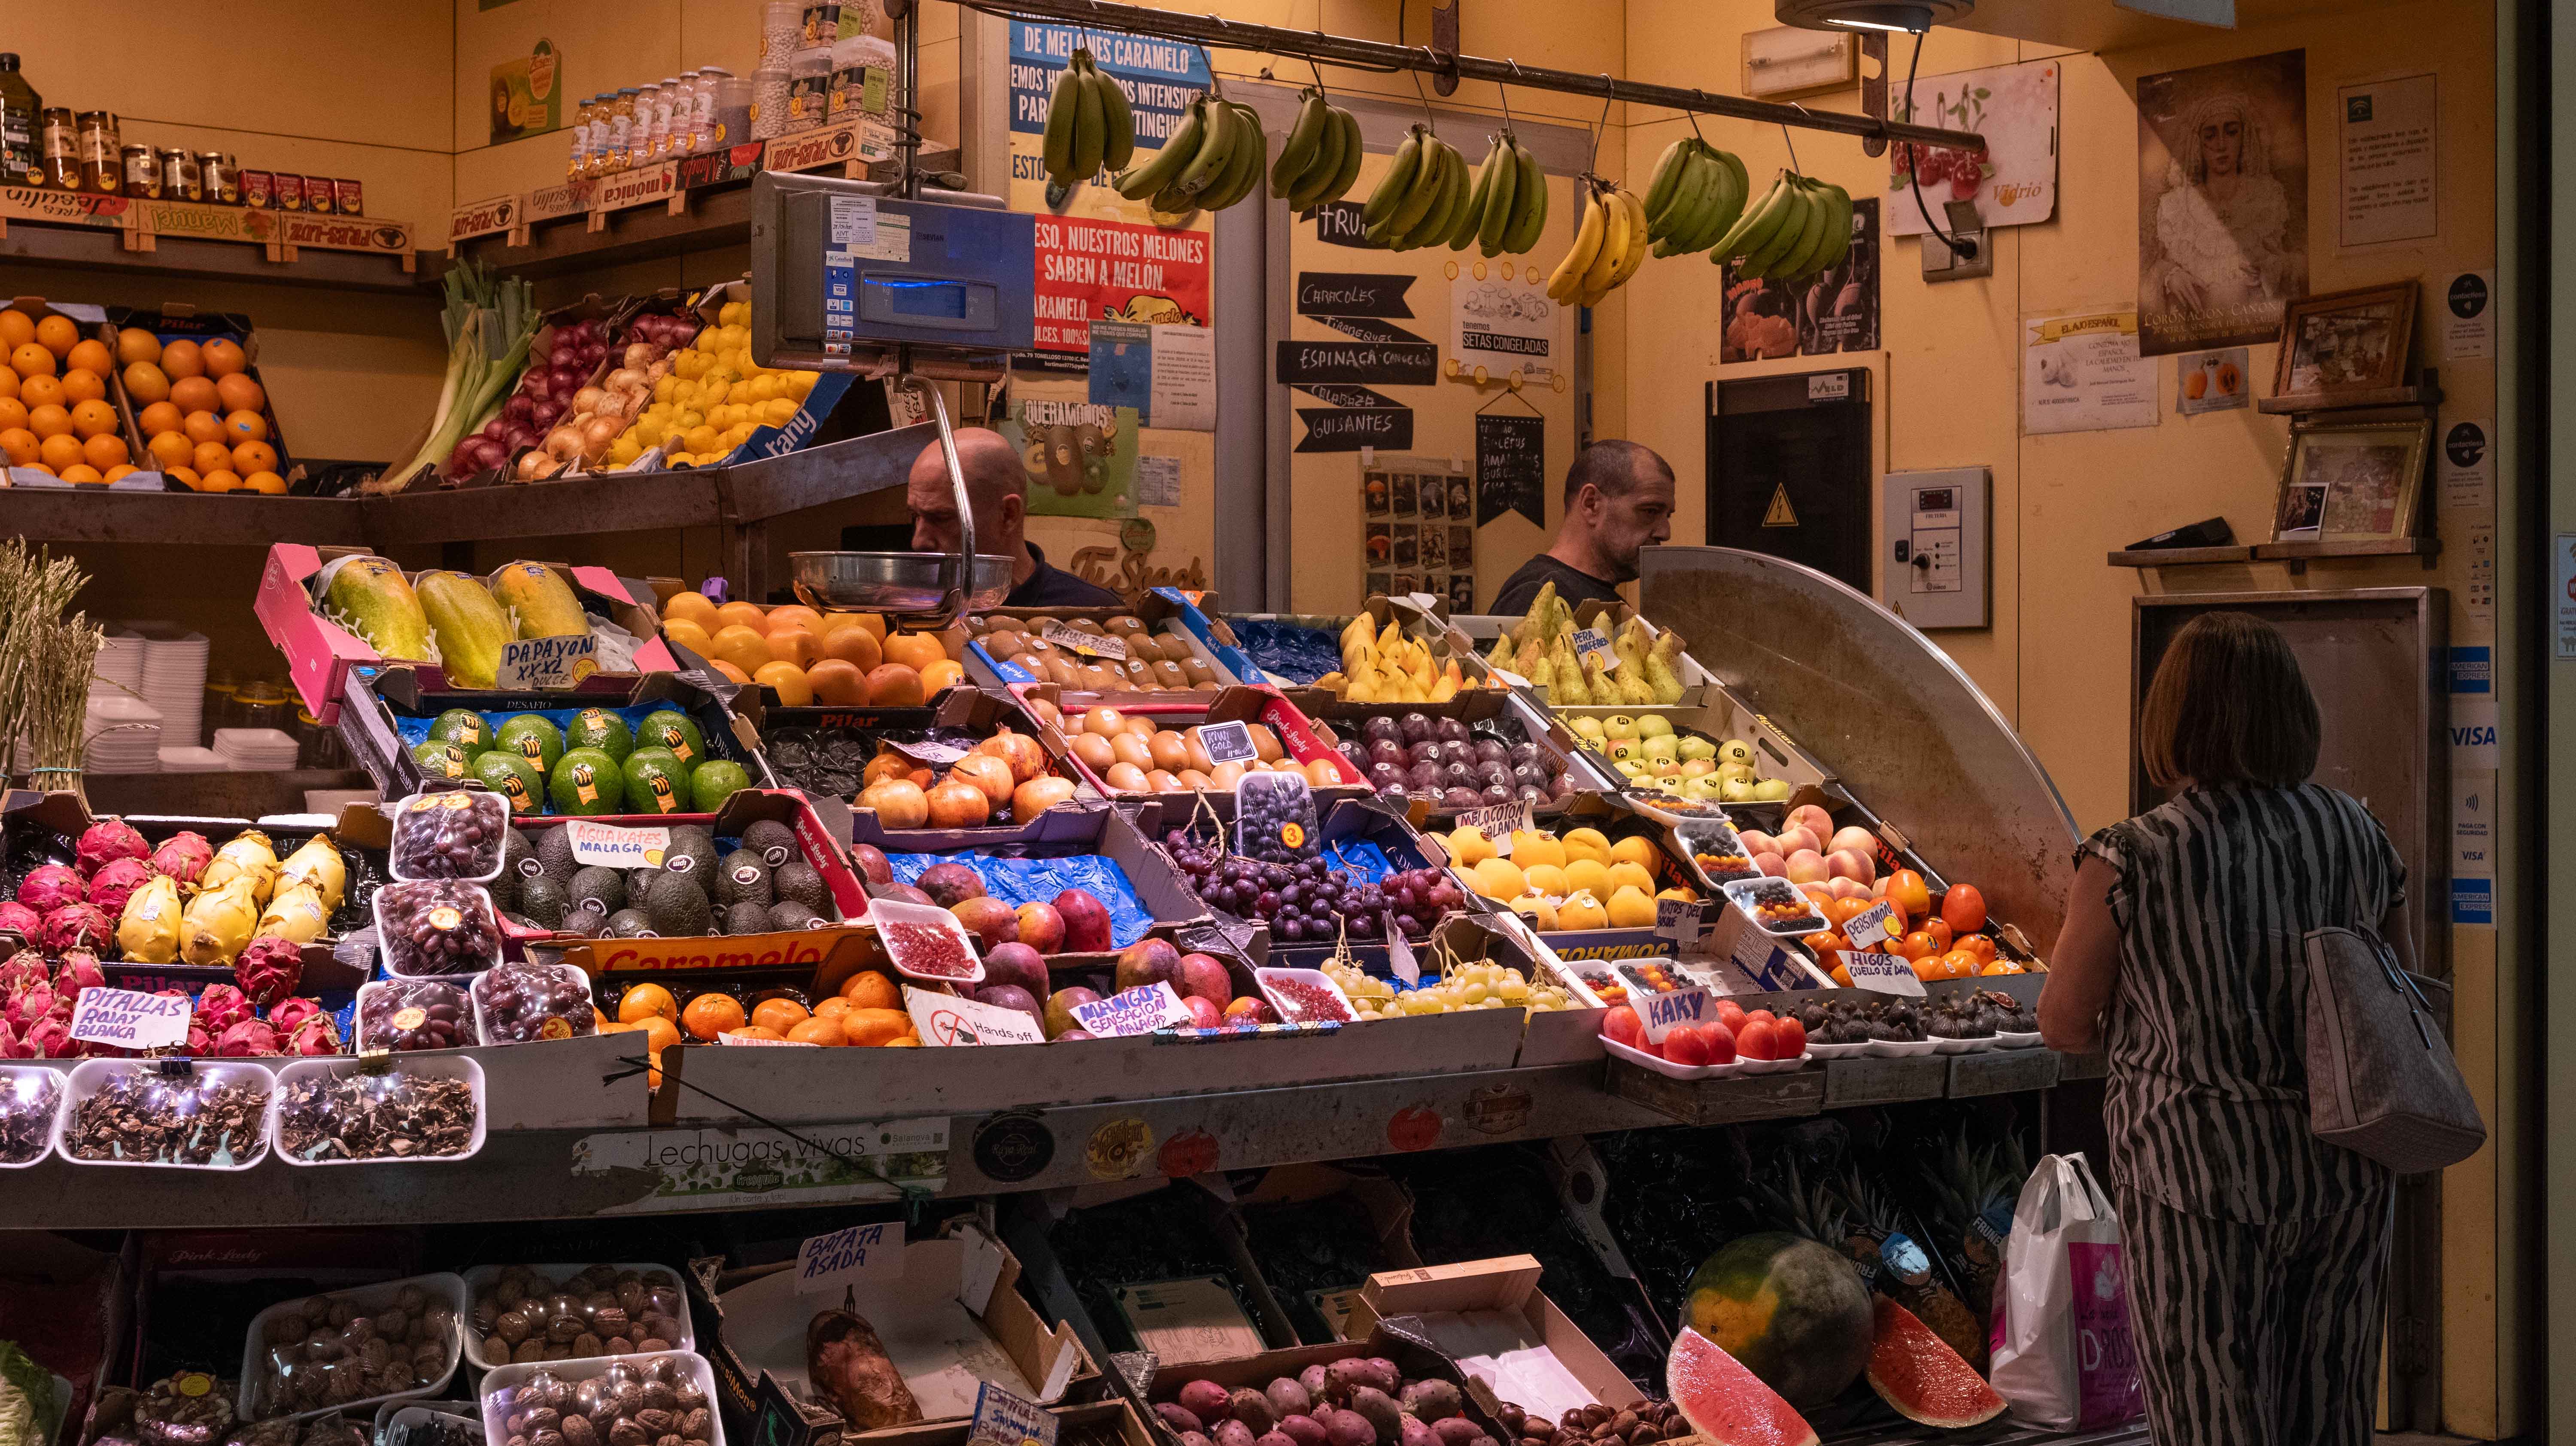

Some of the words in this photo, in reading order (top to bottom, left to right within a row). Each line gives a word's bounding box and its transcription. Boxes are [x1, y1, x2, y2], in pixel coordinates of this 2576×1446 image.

[1025, 26, 1042, 54] DE
[1046, 30, 1111, 63] MELONES
[1115, 39, 1189, 74] CARAMELO
[773, 139, 830, 170] FRES-LUZ
[604, 178, 660, 205] mónica
[1992, 181, 2042, 203] Vidrio
[151, 208, 239, 237] Manuel
[452, 210, 495, 237] FRES-LUZ
[290, 222, 371, 247] FRES-LUZ
[1068, 225, 1139, 257] NUESTROS
[1143, 234, 1204, 264] MELONES
[1045, 254, 1095, 285] SABEN
[1099, 264, 1109, 286] A
[1114, 259, 1166, 292] MELÓN.
[1301, 283, 1376, 304] CARACOLES
[1462, 319, 1490, 331] tenemos
[2061, 325, 2070, 334] EL
[2072, 320, 2087, 331] AJO
[2087, 316, 2120, 328] ESPAÑOL
[1463, 331, 1492, 349] SETAS
[1493, 334, 1548, 355] CONGELADAS
[1573, 631, 1594, 643] PERA
[507, 635, 595, 667] PAPAYON
[516, 657, 563, 681] XXXL
[2449, 662, 2488, 671] AMERICAN
[2457, 671, 2490, 680] EXPRESS
[532, 673, 571, 687] DULCE
[507, 700, 552, 709] DESAFIO
[820, 714, 878, 729] Pilar
[1267, 708, 1289, 735] Pink
[1287, 730, 1309, 755] Lady
[1755, 714, 1795, 746] Aguilar
[1212, 740, 1233, 752] GOLD
[2451, 727, 2497, 746] VISA
[397, 762, 415, 794] DESAFIO
[1460, 802, 1525, 828] MELOCOTON
[575, 824, 662, 846] AGUAKATES
[796, 817, 813, 846] Pink
[812, 841, 829, 869] Lady
[580, 841, 642, 854] MALAGA
[2462, 851, 2484, 860] VISA
[2452, 892, 2489, 901] AMERICAN
[2460, 902, 2491, 911] EXPRESS
[1658, 899, 1682, 915] MIXTOS
[1686, 905, 1700, 918] DEL
[1656, 915, 1677, 928] BOSQUE
[603, 940, 821, 972] Caramelo
[1850, 952, 1893, 966] HIGOS
[1882, 965, 1892, 976] DE
[120, 975, 204, 993] Pilar
[1079, 983, 1164, 1021] MANGOS
[1649, 990, 1705, 1030] KAKY
[1089, 999, 1166, 1033] SENSACION
[73, 1024, 137, 1041] BLANCA
[975, 1021, 1014, 1039] Hands
[1017, 1030, 1032, 1042] off
[892, 1133, 931, 1143] Salanova
[648, 1135, 784, 1169] Lechugas
[794, 1133, 865, 1157] vivas
[742, 1194, 762, 1203] corte
[806, 1224, 884, 1258] BATATA
[169, 1249, 215, 1264] Pink
[218, 1249, 266, 1263] Lady
[804, 1248, 867, 1279] ASADA
